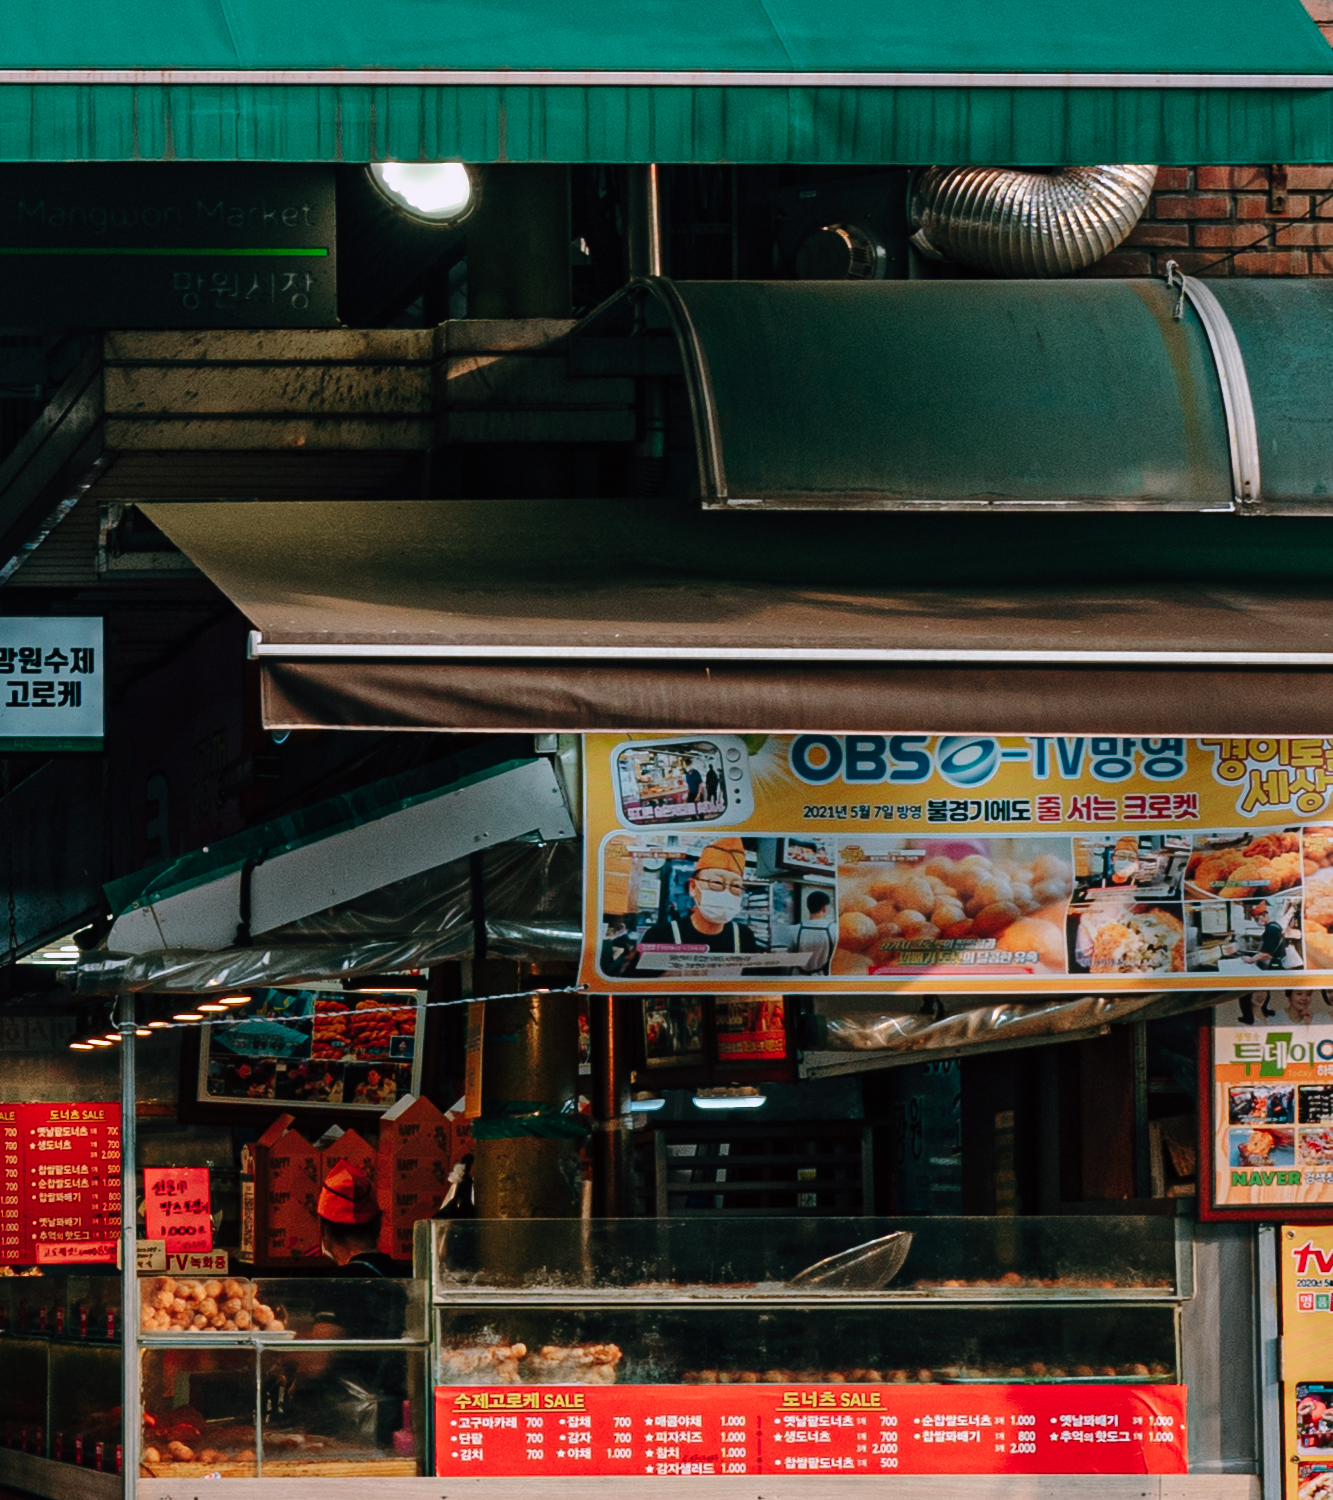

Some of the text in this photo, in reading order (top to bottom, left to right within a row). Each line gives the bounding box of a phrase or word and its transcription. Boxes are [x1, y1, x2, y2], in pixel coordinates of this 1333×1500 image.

[197, 199, 314, 229] Market
[171, 270, 314, 311] 망원시장
[5, 681, 82, 707] 고로케
[803, 793, 1201, 822] 2021년 5월 7일 방영 불경기에도 줄 서는 크로켓
[81, 1110, 105, 1120] SALE
[1231, 1171, 1302, 1186] NAVER
[190, 1255, 226, 1270] 녹화중
[454, 1391, 881, 1409] 수제고로케 SALE 도너츠 SALE
[458, 1416, 543, 1429] 고구마카레 700
[654, 1431, 703, 1443] 피자치즈
[879, 1431, 898, 1442] 700
